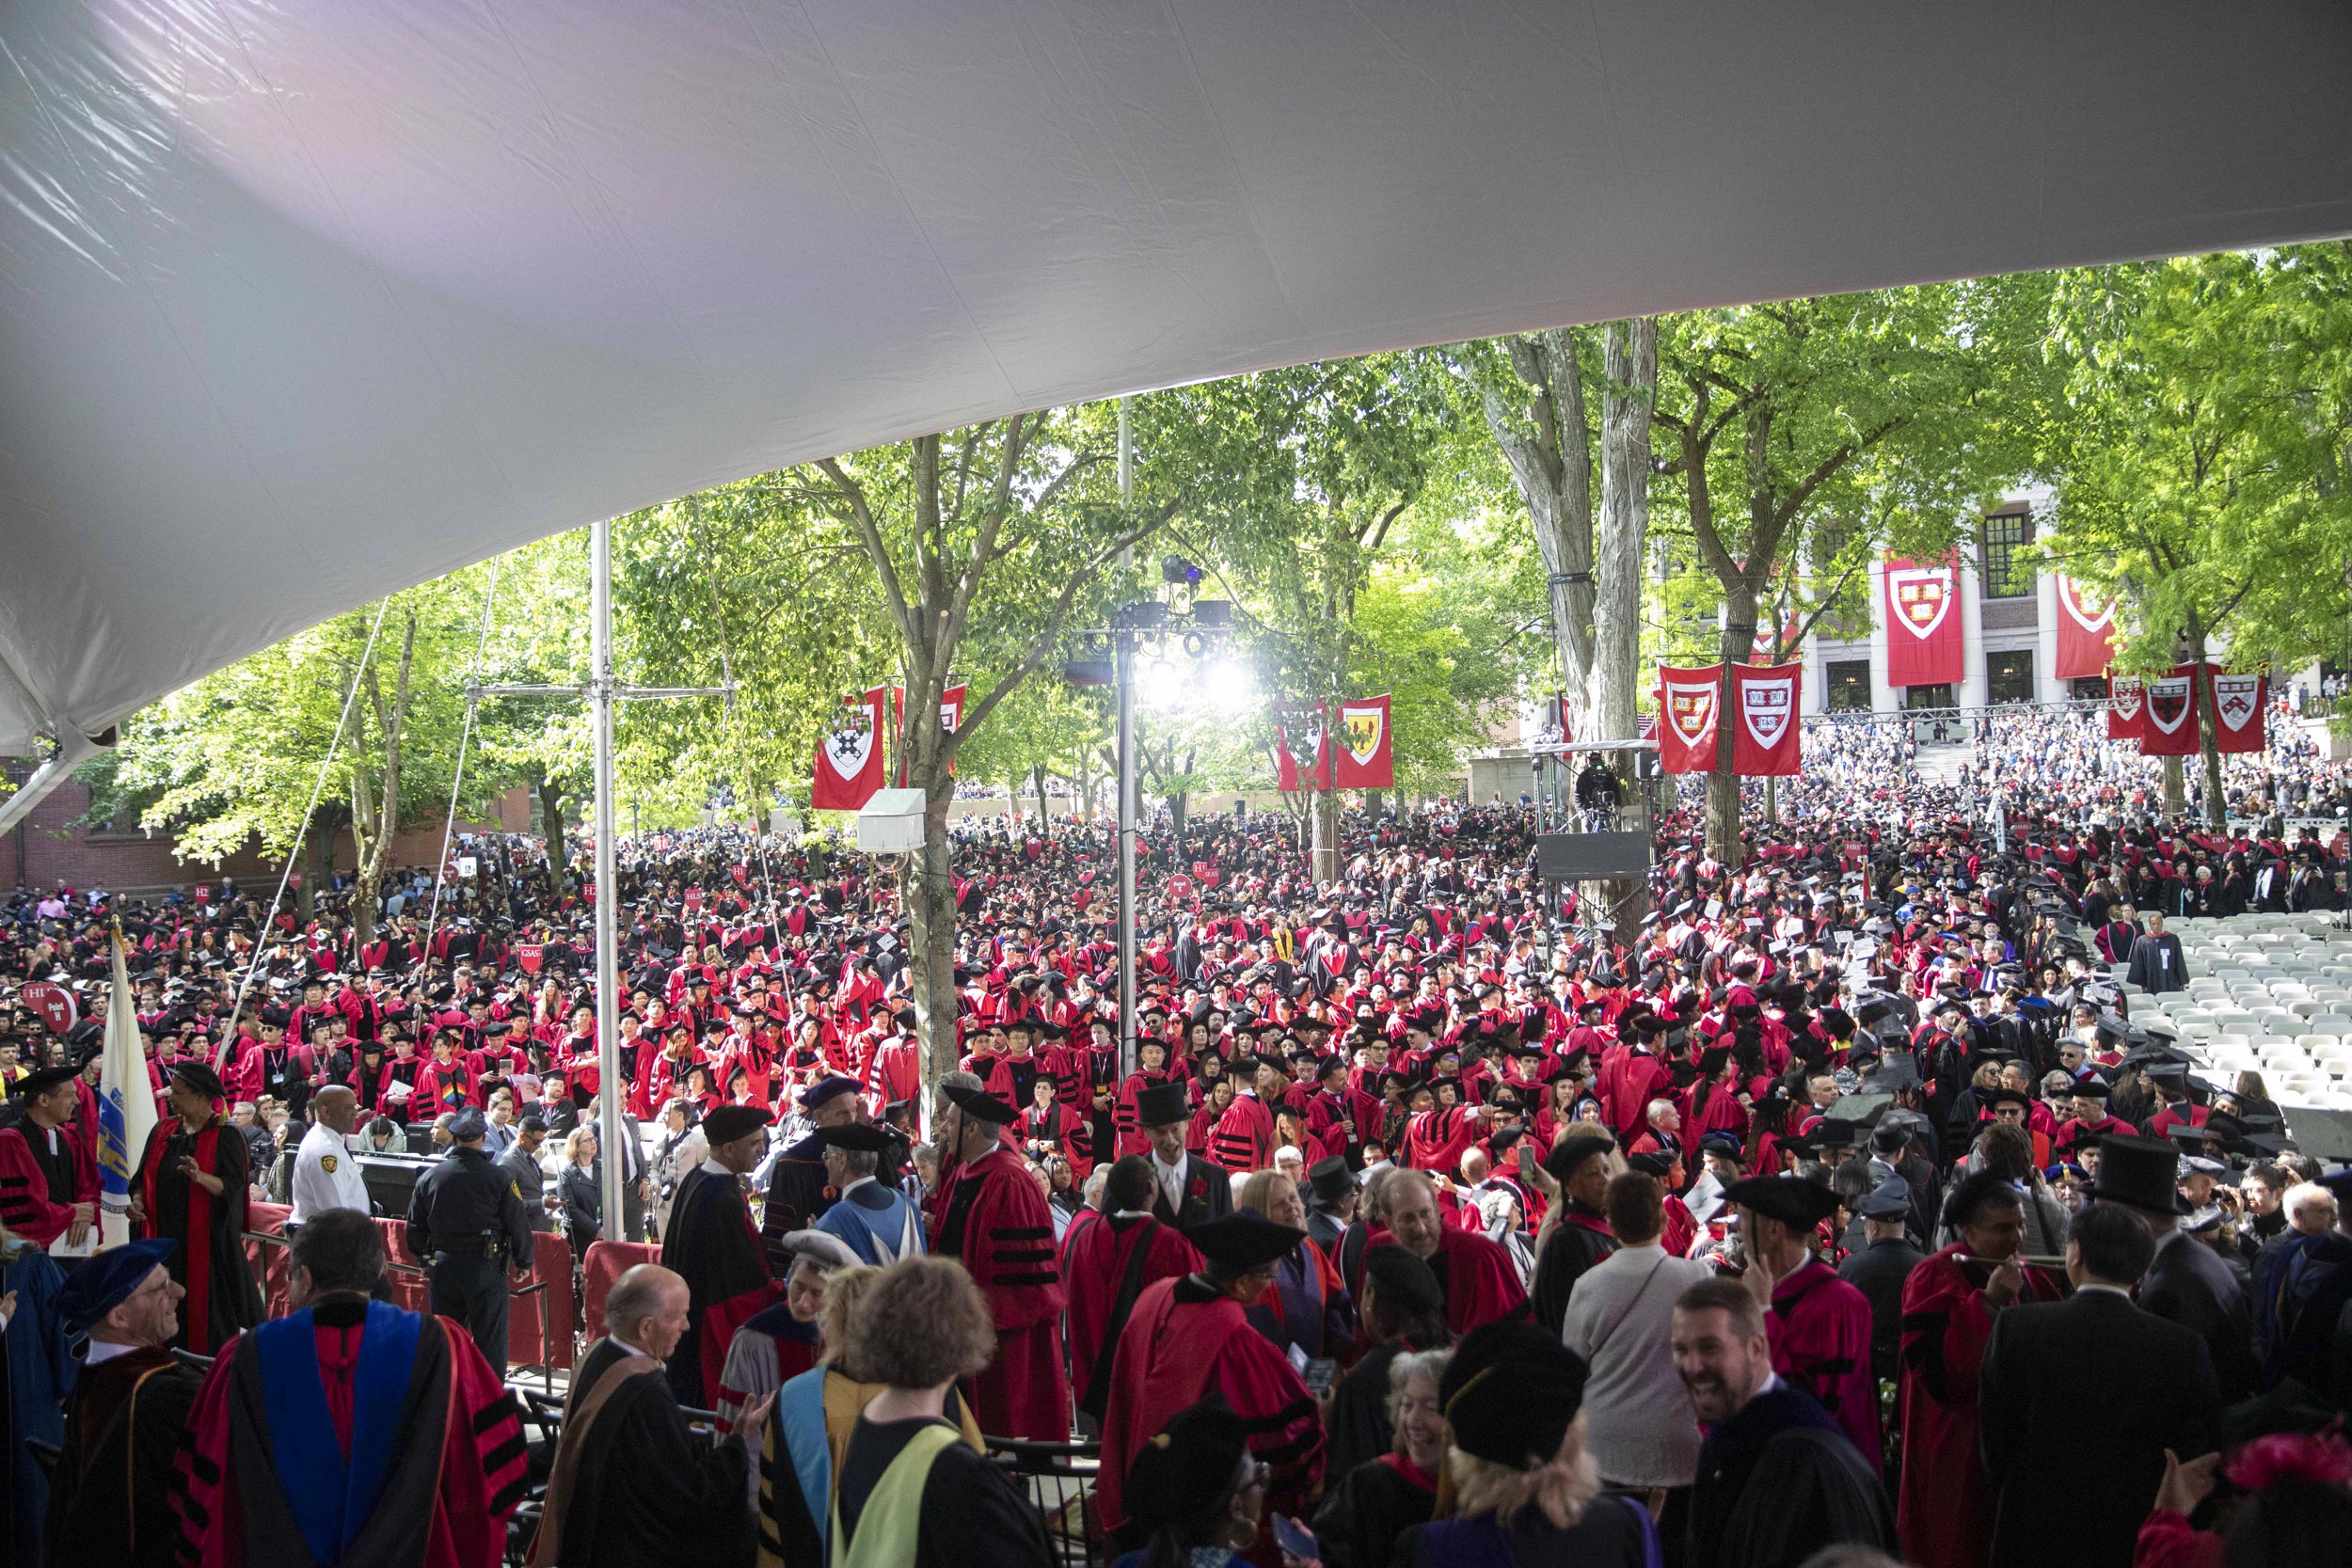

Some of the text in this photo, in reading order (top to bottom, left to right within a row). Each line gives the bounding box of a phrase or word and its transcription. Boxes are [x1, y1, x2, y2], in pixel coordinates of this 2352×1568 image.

[1772, 692, 1782, 701] RI
[1677, 699, 1687, 707] VE
[2342, 842, 2350, 857] 5
[196, 887, 209, 897] H2
[521, 949, 539, 958] GSAS
[48, 1002, 64, 1012] Point
[55, 1011, 62, 1022] H
